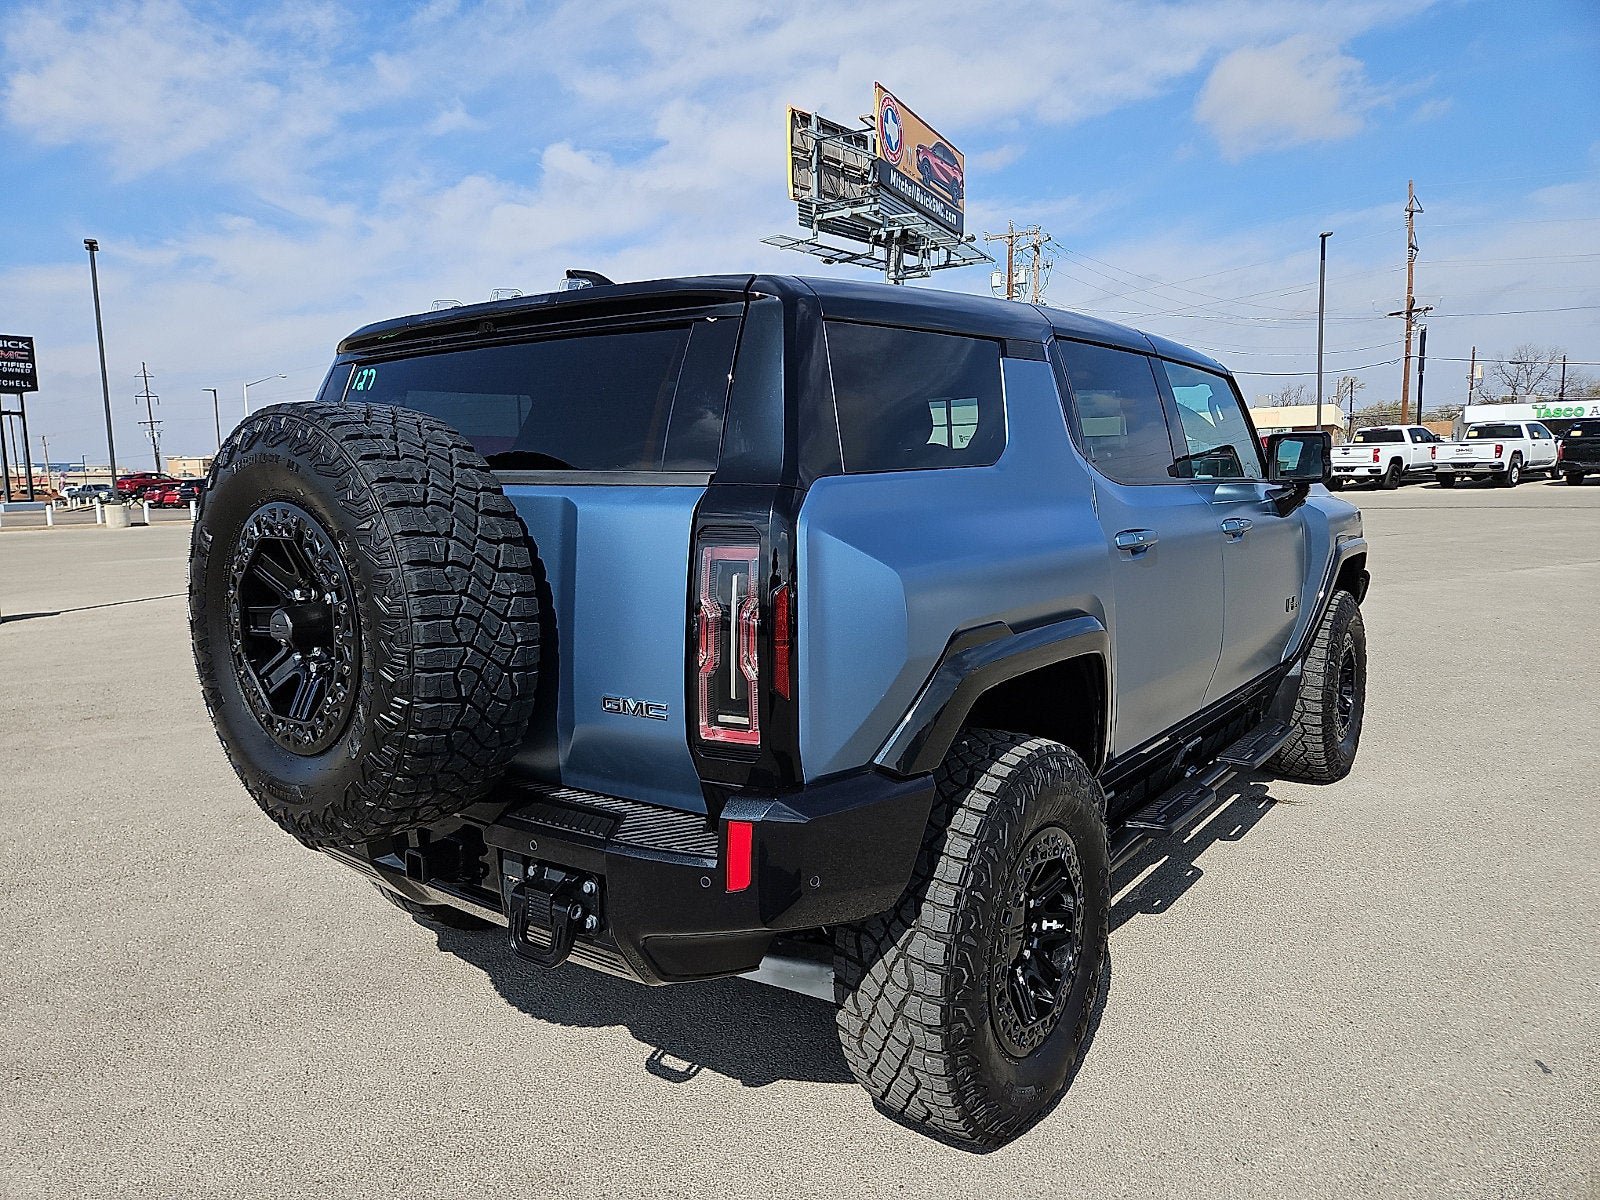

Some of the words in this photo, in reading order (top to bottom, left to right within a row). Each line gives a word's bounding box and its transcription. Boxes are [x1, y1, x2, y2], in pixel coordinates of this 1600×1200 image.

[352, 368, 377, 391] 127
[1531, 404, 1585, 419] TASCO
[601, 694, 668, 721] GMC
